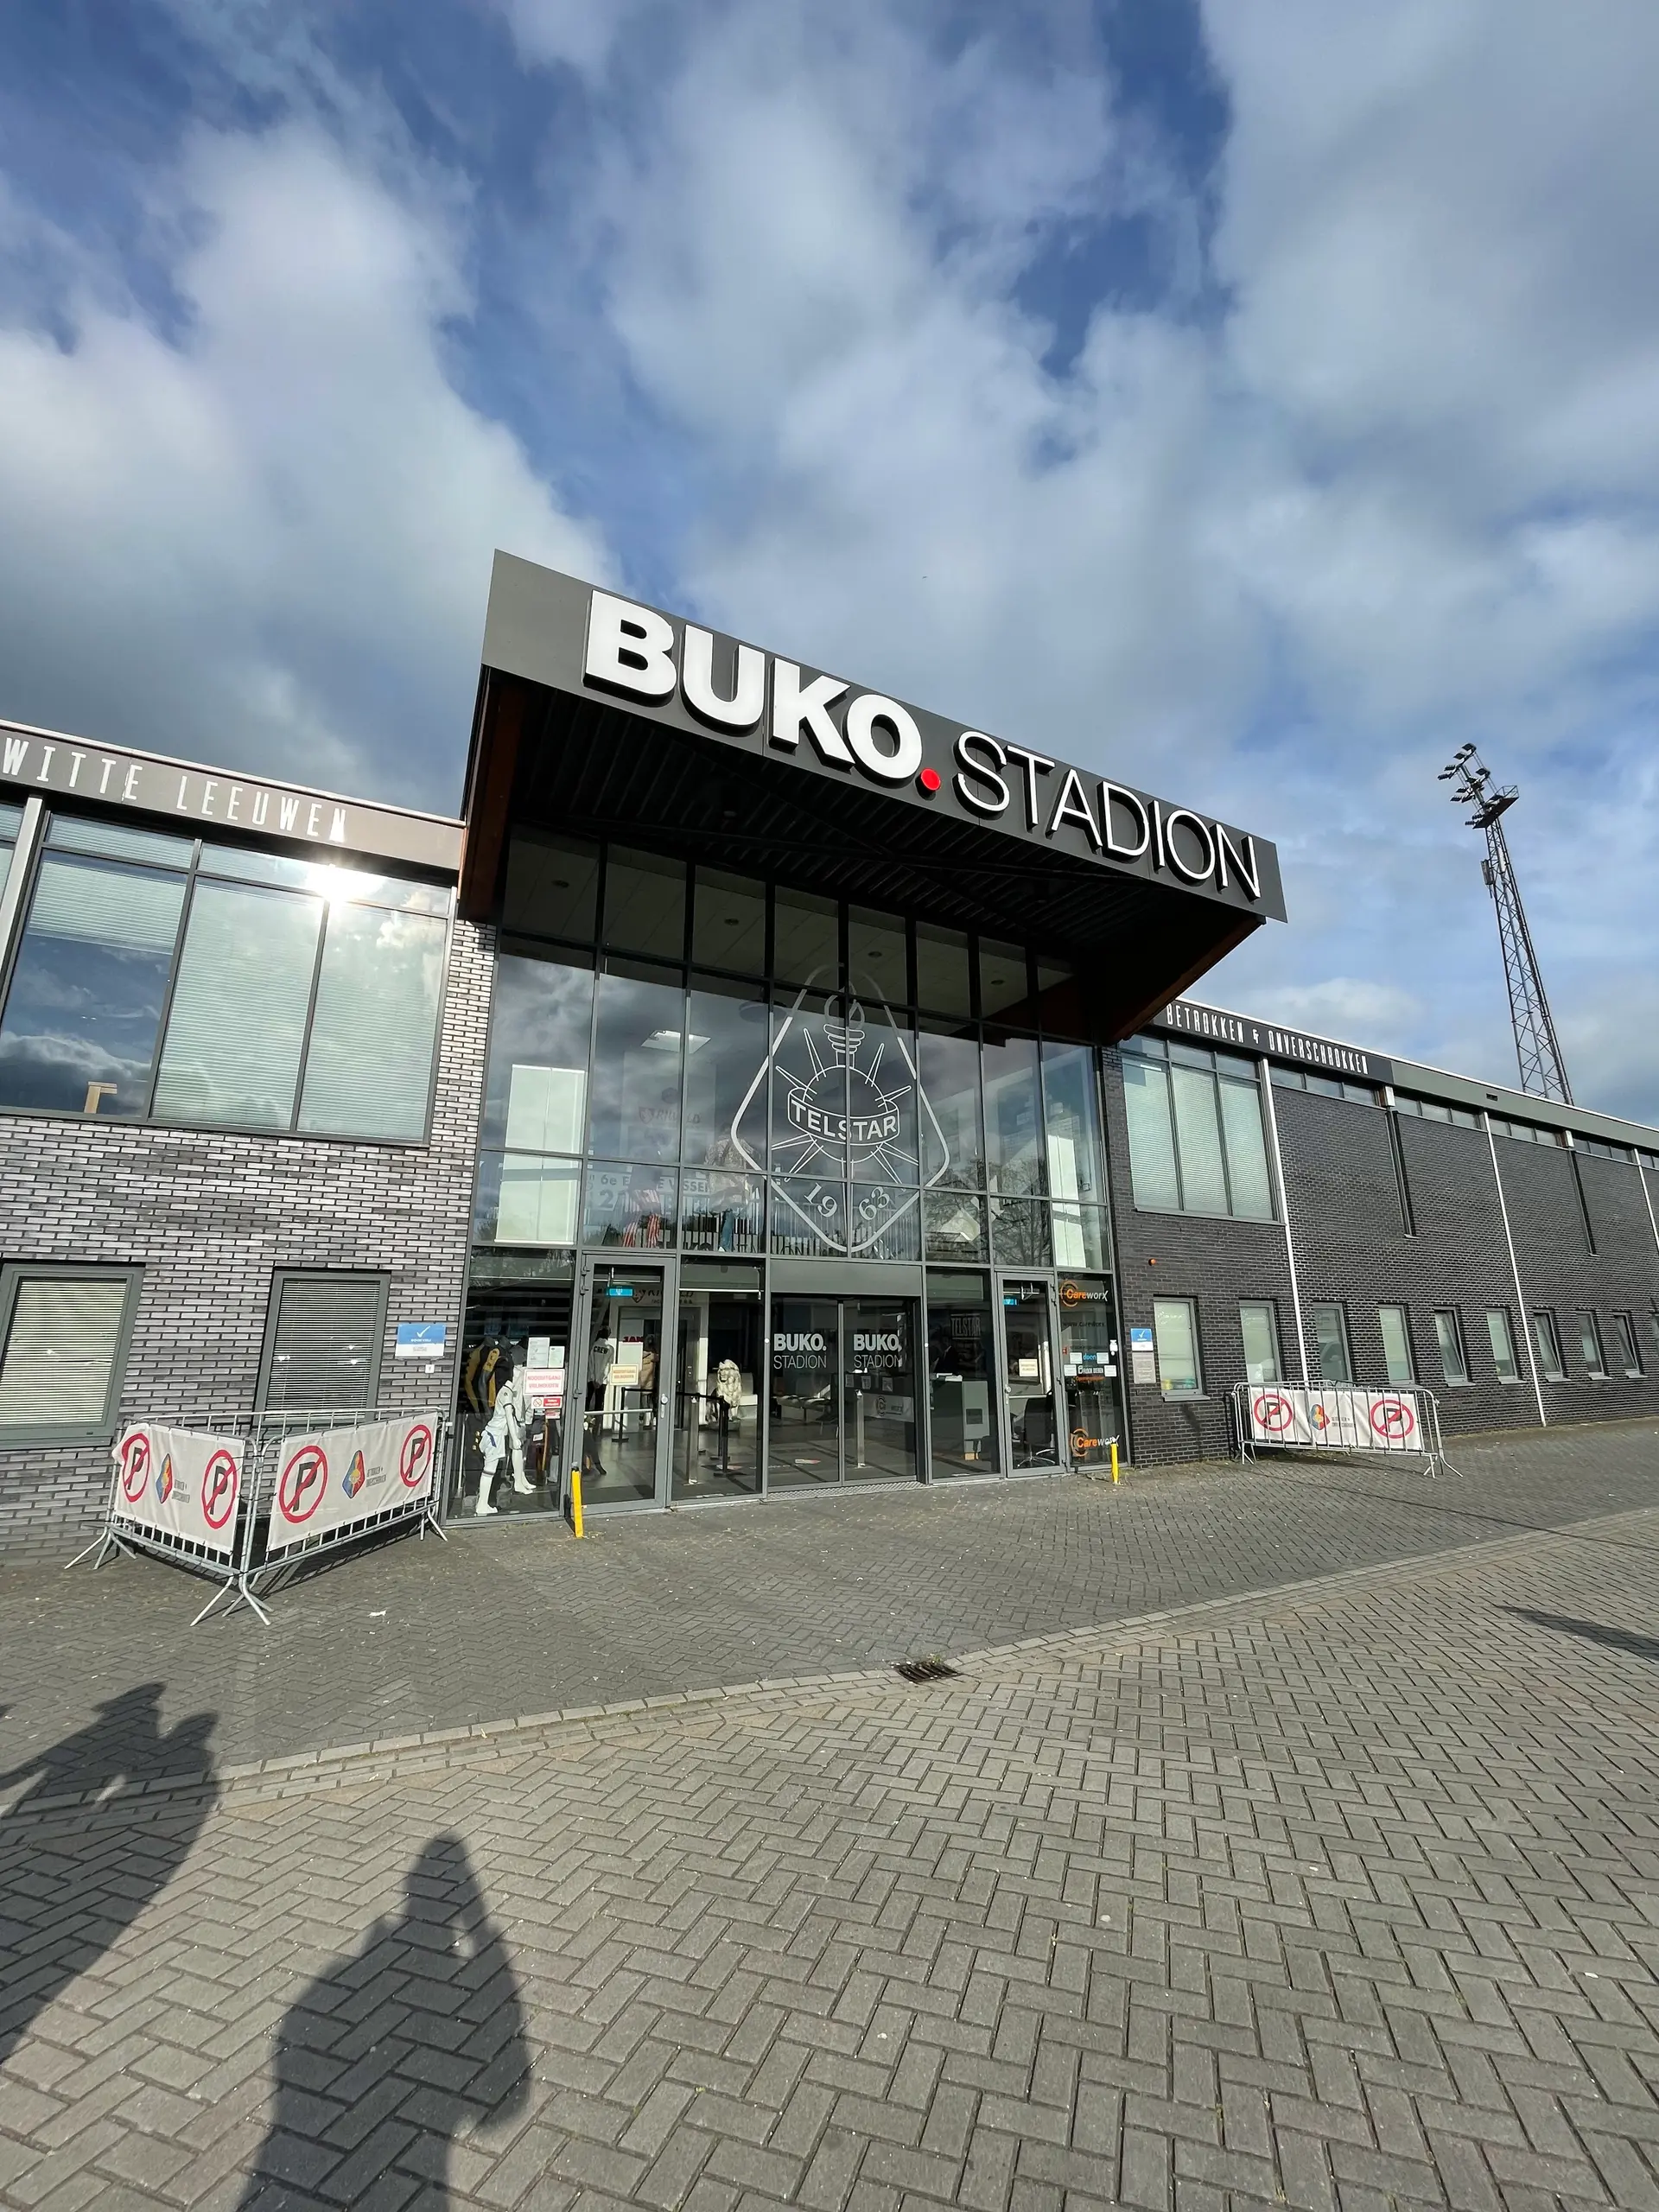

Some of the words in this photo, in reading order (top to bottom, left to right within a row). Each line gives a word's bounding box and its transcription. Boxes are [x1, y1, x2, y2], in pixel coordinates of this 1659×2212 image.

[583, 589, 942, 798] BUKO.
[954, 730, 1262, 901] STADION
[3, 737, 143, 802] WITTE
[176, 776, 346, 843] LEEUWEN
[1166, 1003, 1244, 1044] BETROKKEN
[1268, 1030, 1369, 1075] ONVERSCHROKKEN
[791, 1099, 897, 1141] TELSTAR
[804, 1182, 837, 1217] 19
[859, 1186, 890, 1221] 63
[594, 1346, 608, 1355] CREW
[773, 1333, 827, 1351] BUKO.
[773, 1354, 827, 1369] STADION
[854, 1354, 902, 1369] STADION
